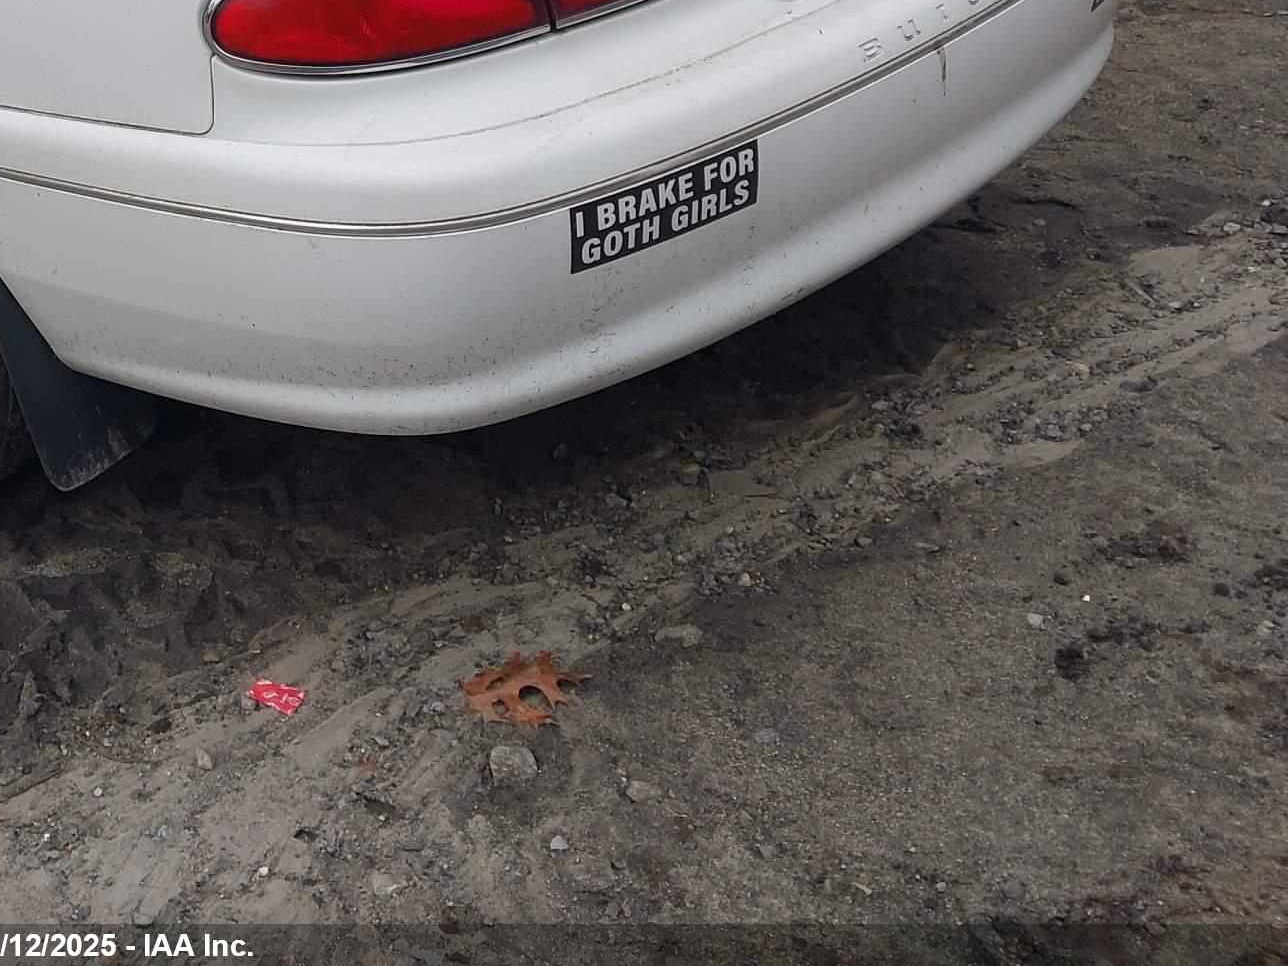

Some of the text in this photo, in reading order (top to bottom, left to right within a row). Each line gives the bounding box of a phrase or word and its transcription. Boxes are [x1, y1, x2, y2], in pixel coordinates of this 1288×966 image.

[575, 148, 755, 239] I BRAKE FOR
[581, 179, 750, 265] GOTH GIRLS
